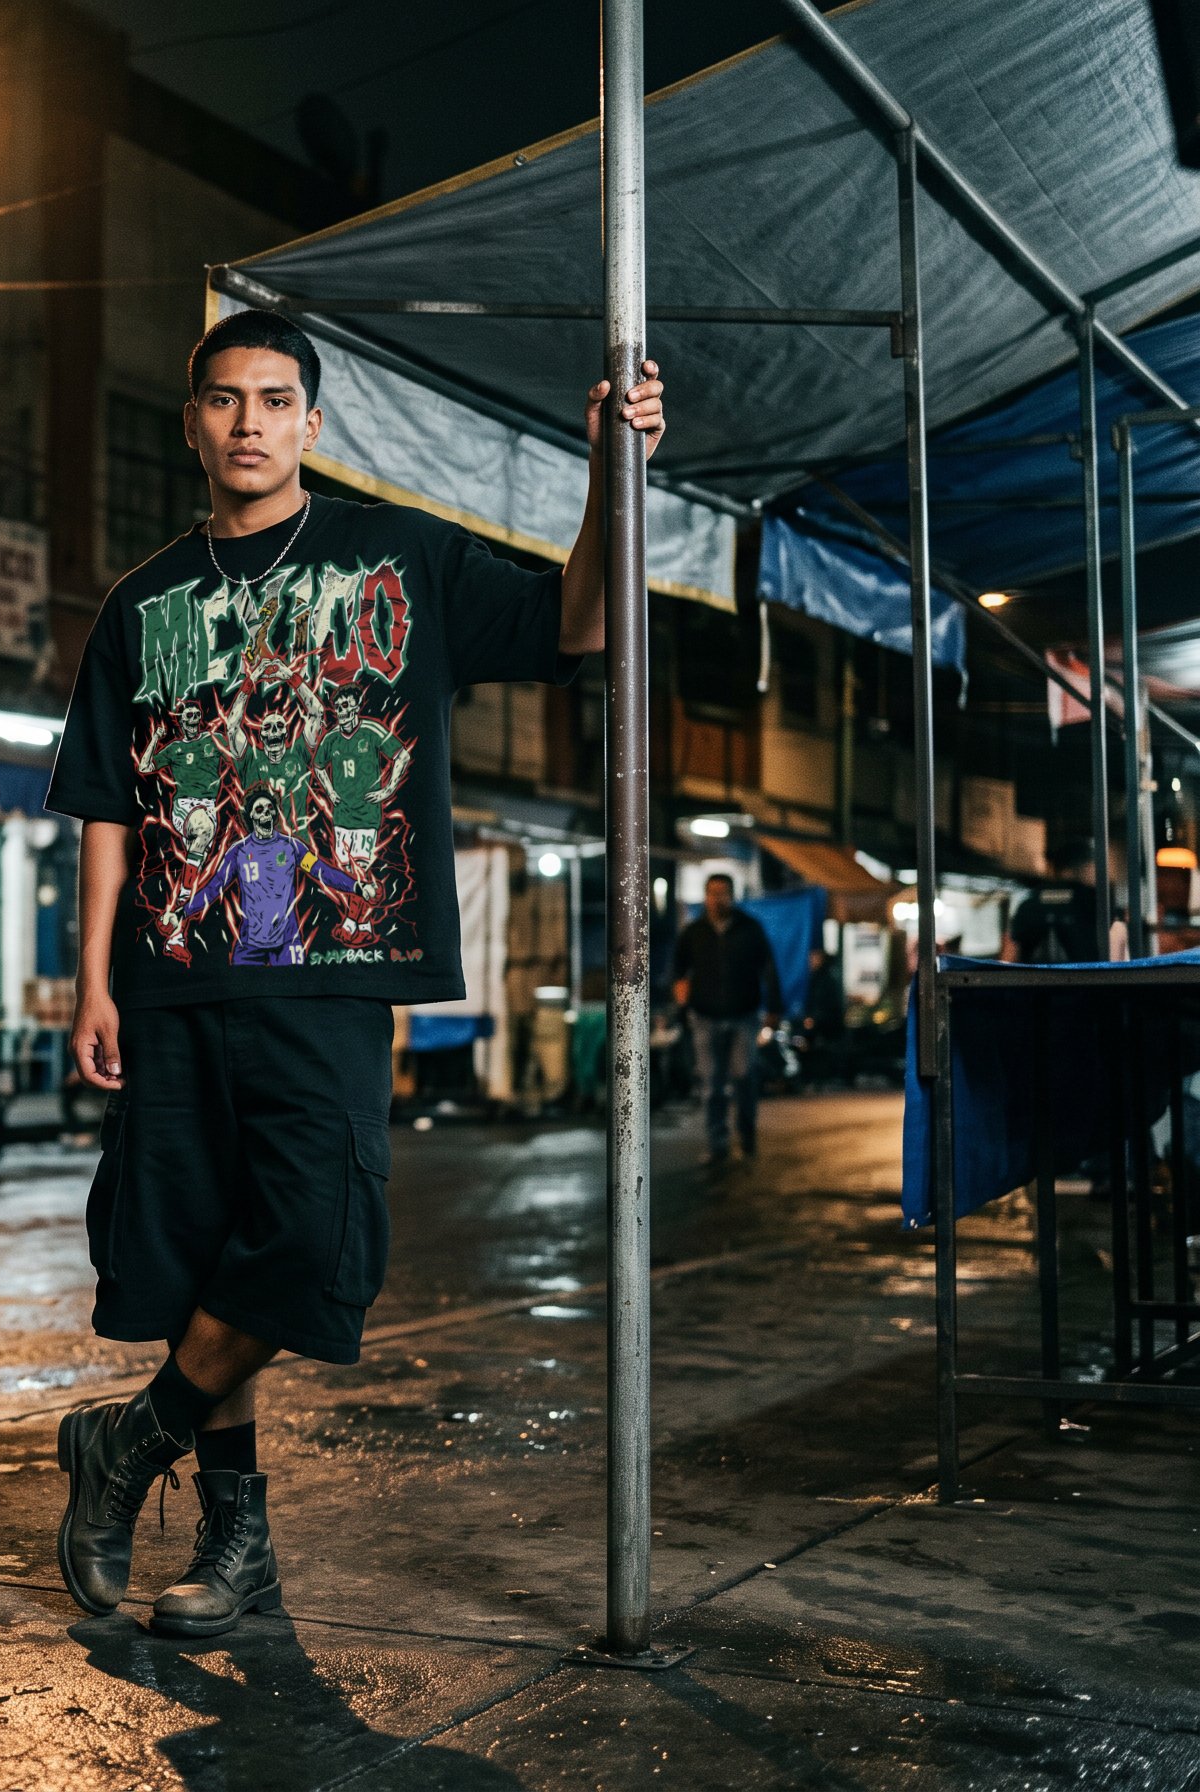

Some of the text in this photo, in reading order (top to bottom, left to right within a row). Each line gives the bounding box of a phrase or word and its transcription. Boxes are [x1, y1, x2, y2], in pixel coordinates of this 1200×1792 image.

[186, 752, 194, 765] 9
[343, 759, 355, 778] 19
[243, 861, 259, 882] 13
[289, 945, 304, 965] 13
[310, 947, 424, 966] SNAPBACK BLVD
